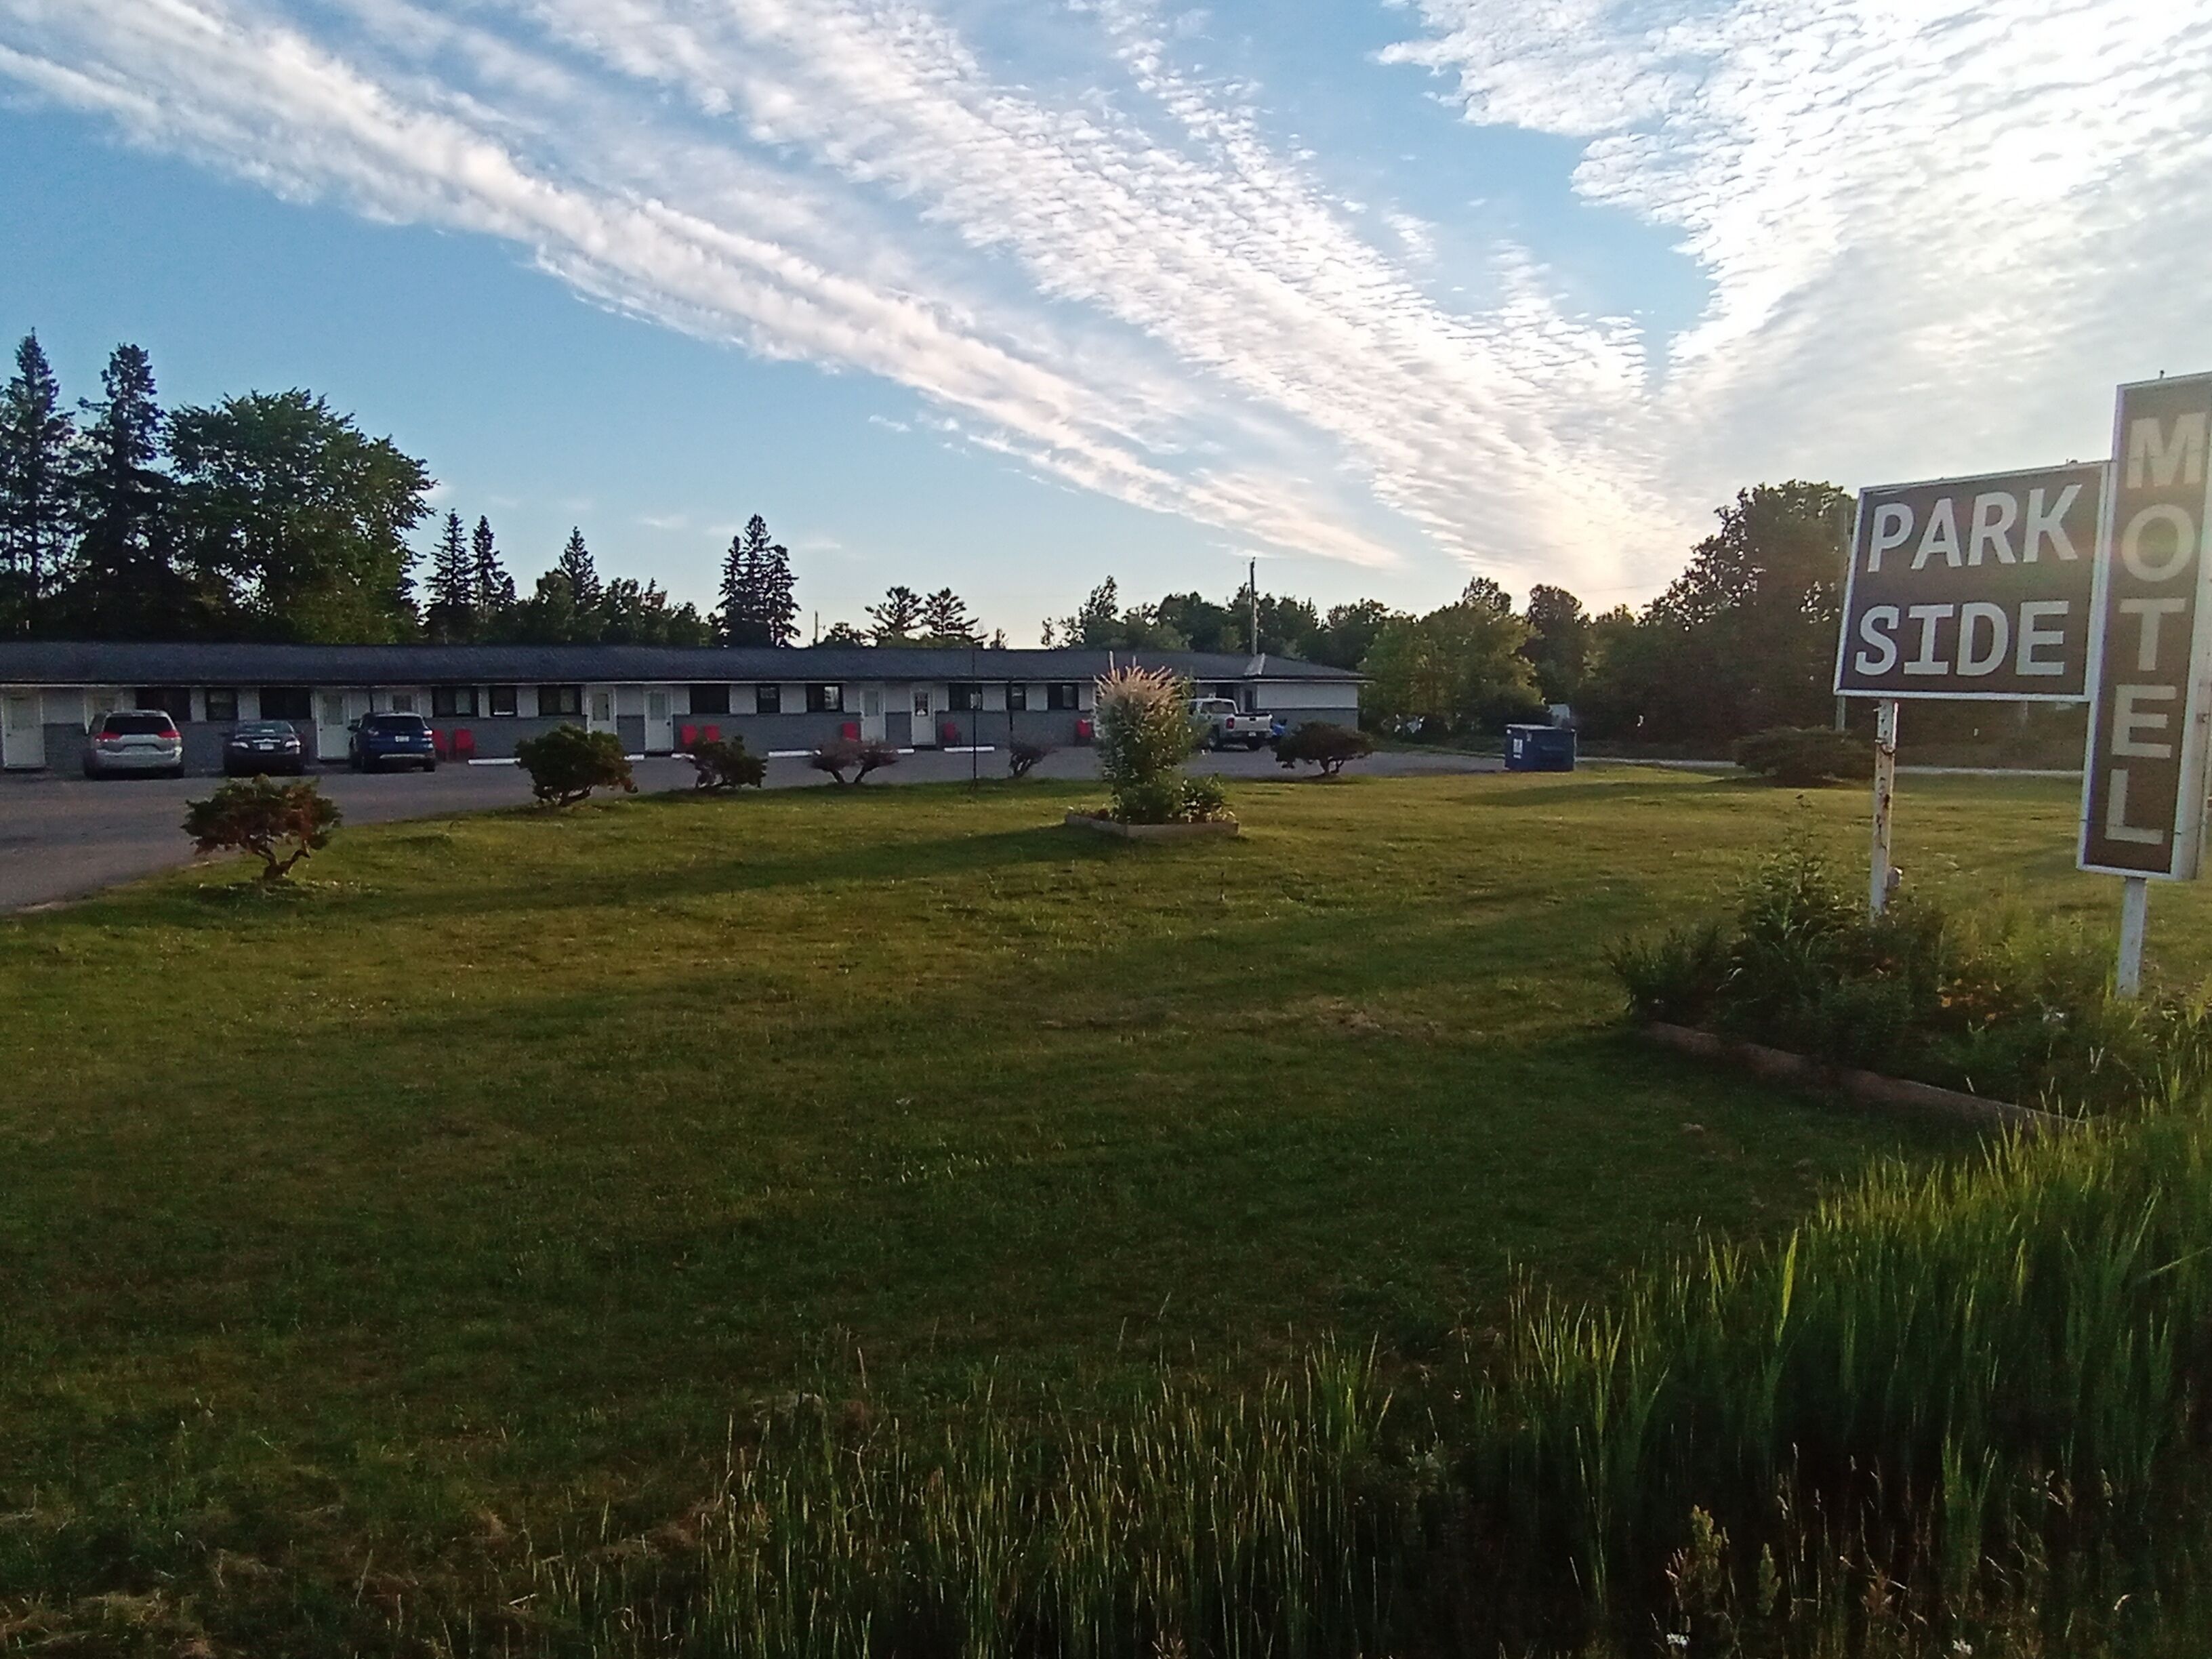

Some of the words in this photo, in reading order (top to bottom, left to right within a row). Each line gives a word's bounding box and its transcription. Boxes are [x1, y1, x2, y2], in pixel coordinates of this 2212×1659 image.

[1868, 484, 2083, 573] PARK
[1855, 600, 2070, 676] SIDE
[2106, 411, 2207, 845] MOTEL
